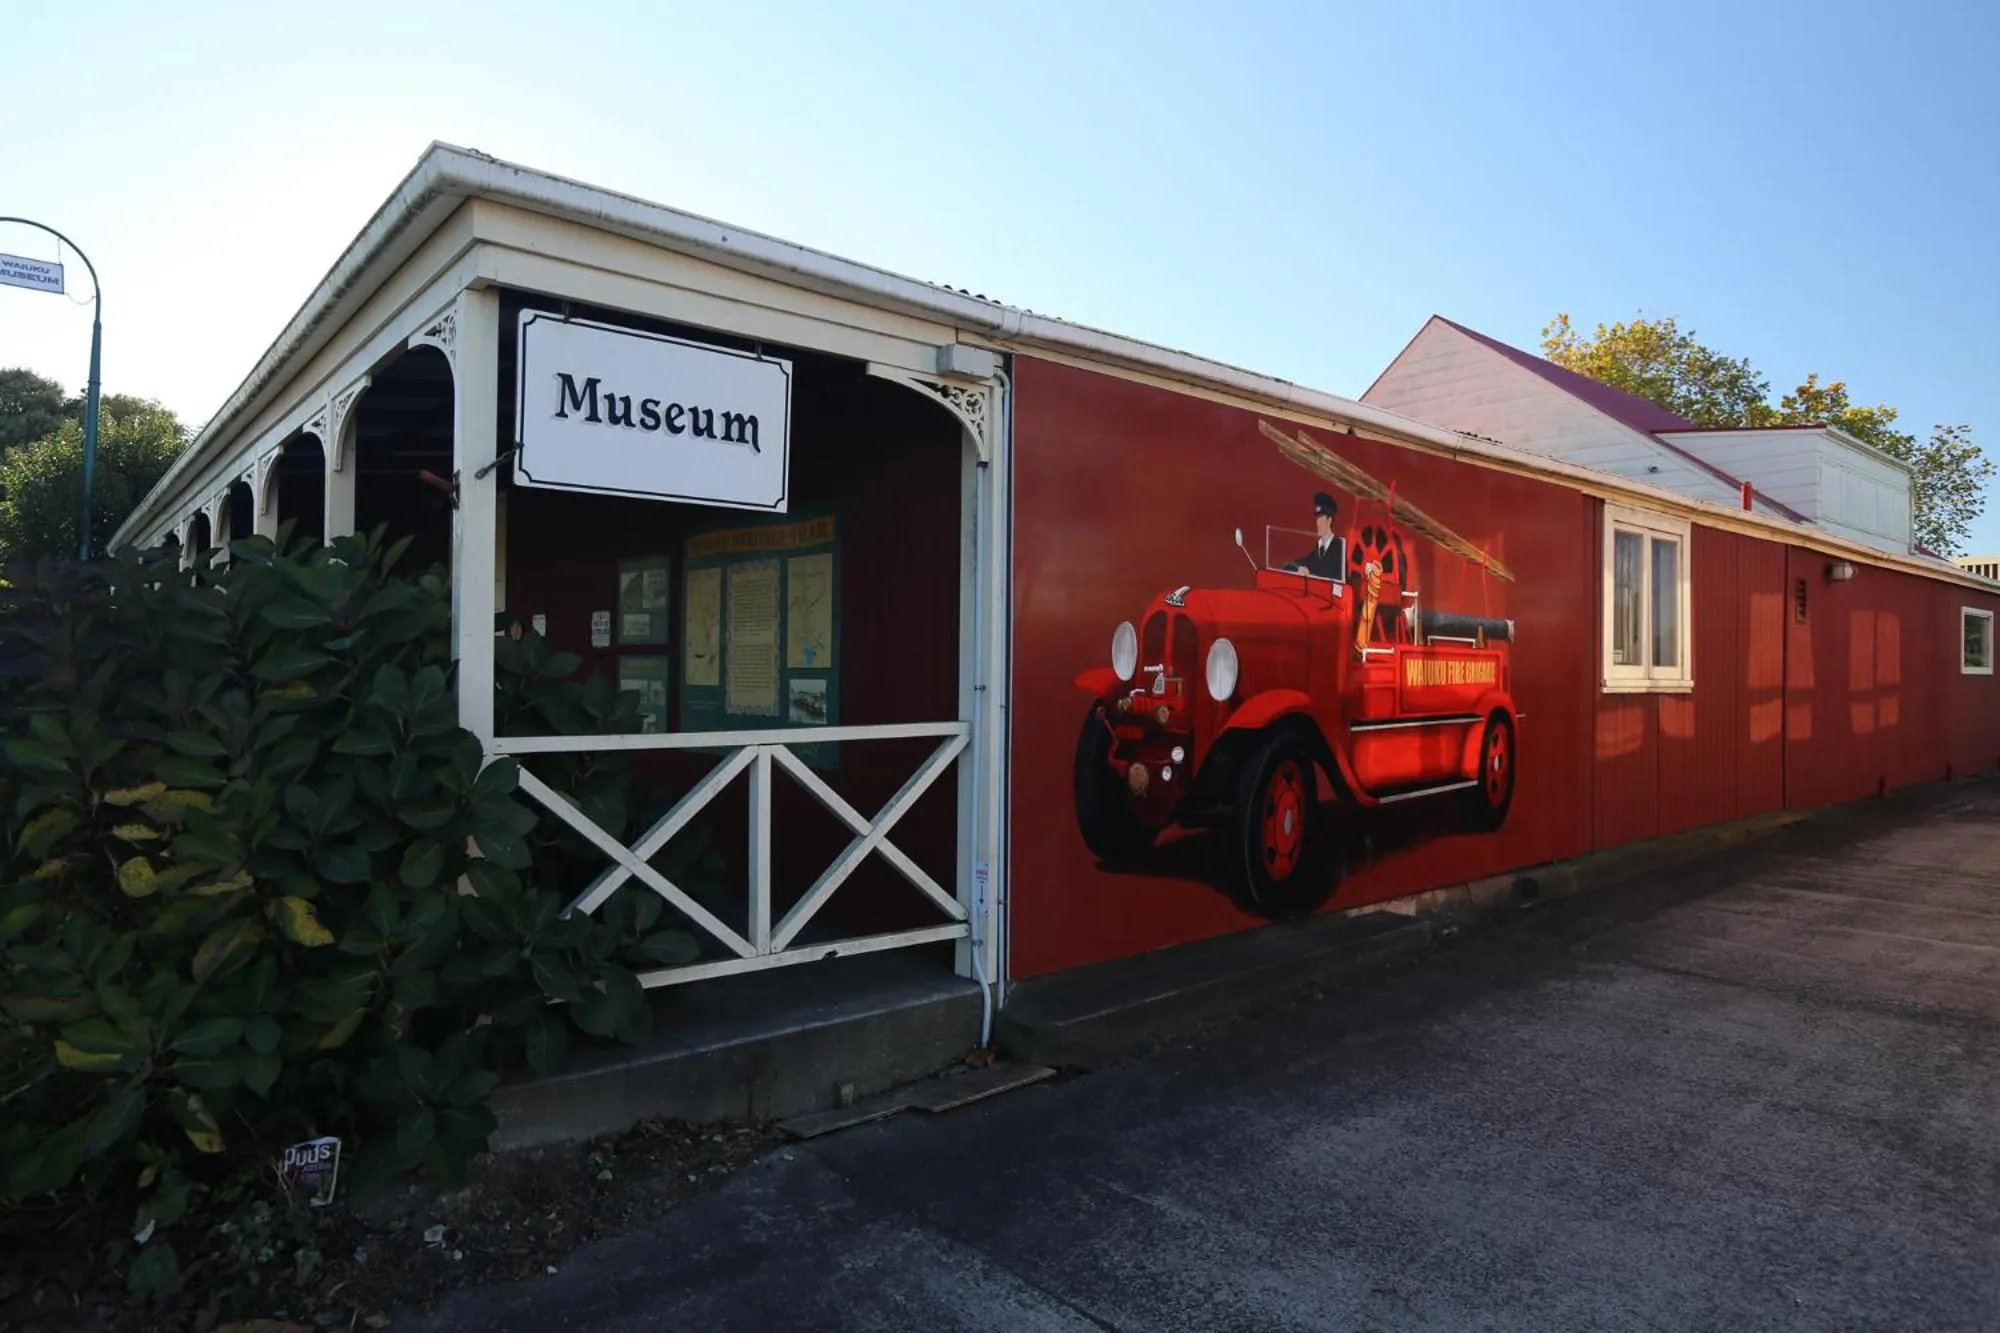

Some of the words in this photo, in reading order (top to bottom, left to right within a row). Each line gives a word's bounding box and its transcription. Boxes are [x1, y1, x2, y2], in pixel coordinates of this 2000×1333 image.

[1, 260, 50, 274] WAIUKU
[555, 372, 761, 453] Museum
[1406, 659, 1446, 686] WAIUKU
[1448, 660, 1465, 684] FIRE
